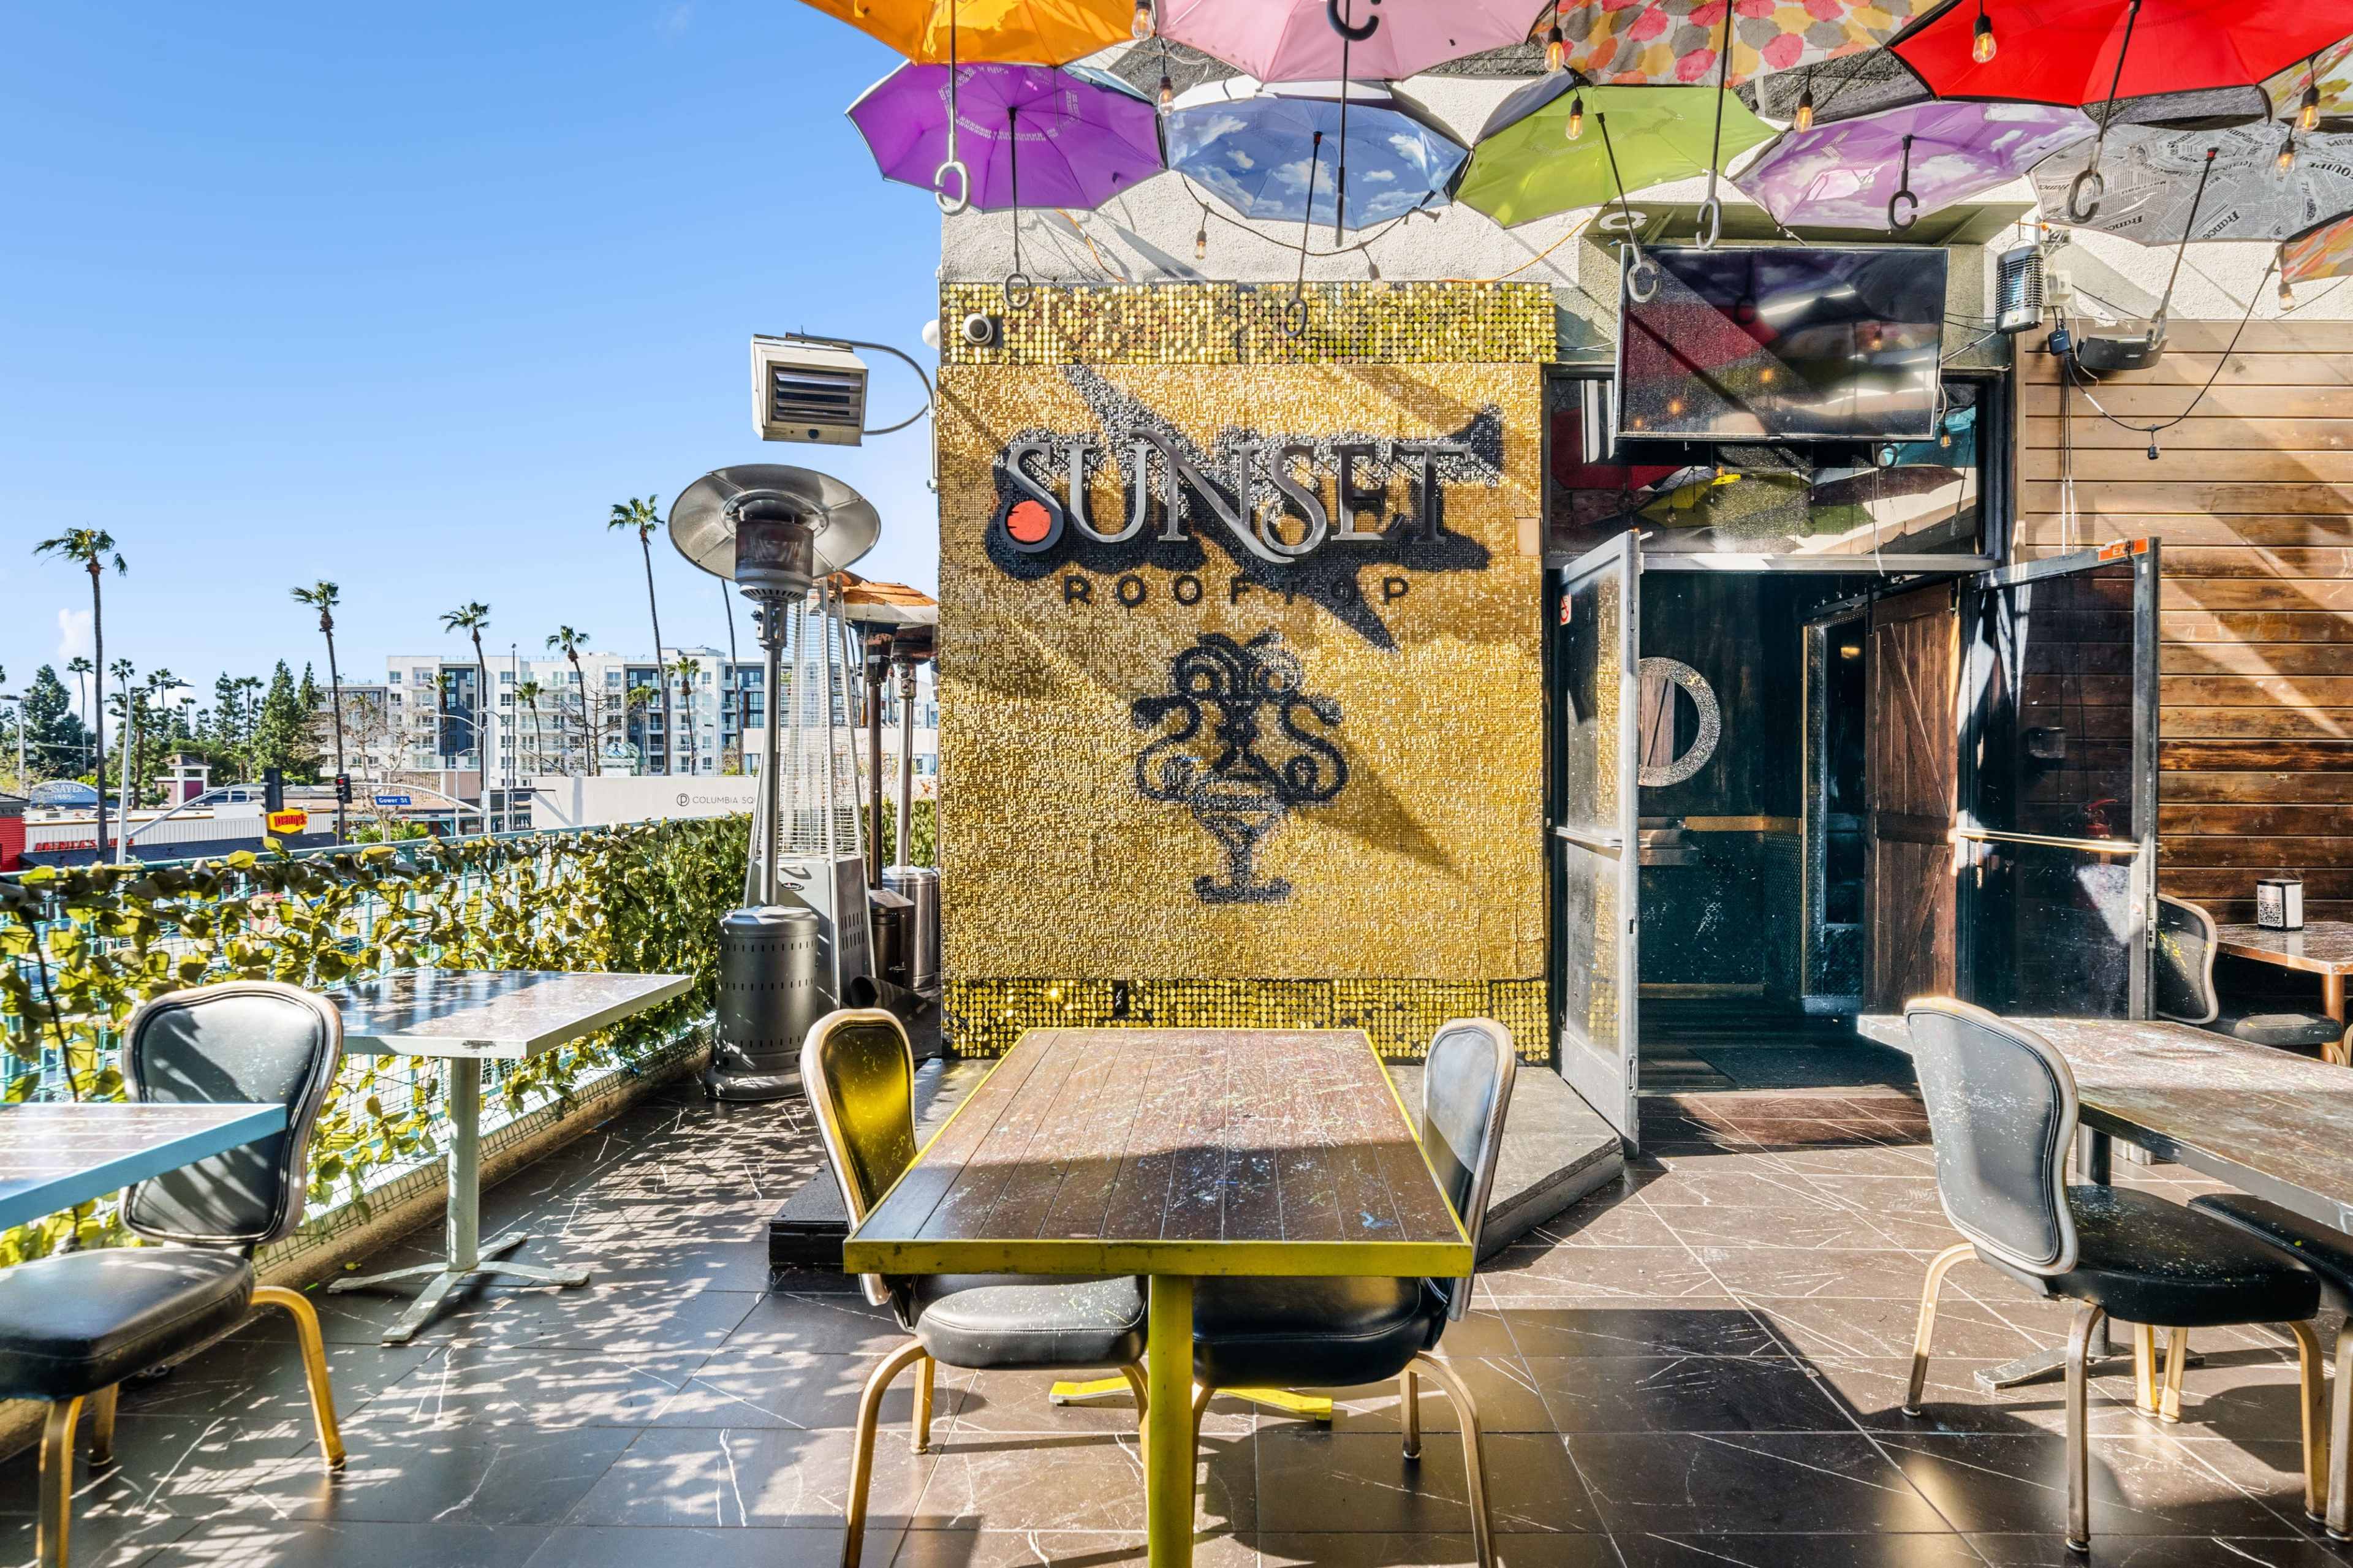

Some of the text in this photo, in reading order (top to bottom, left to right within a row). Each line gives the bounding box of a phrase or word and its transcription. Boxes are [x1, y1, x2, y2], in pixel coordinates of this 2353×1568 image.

[2202, 210, 2240, 241] France
[1003, 427, 1472, 564] SUNSET
[1063, 575, 1411, 607] ROOFTOP
[275, 814, 308, 827] Denny's
[34, 839, 97, 852] AMERICA'S
